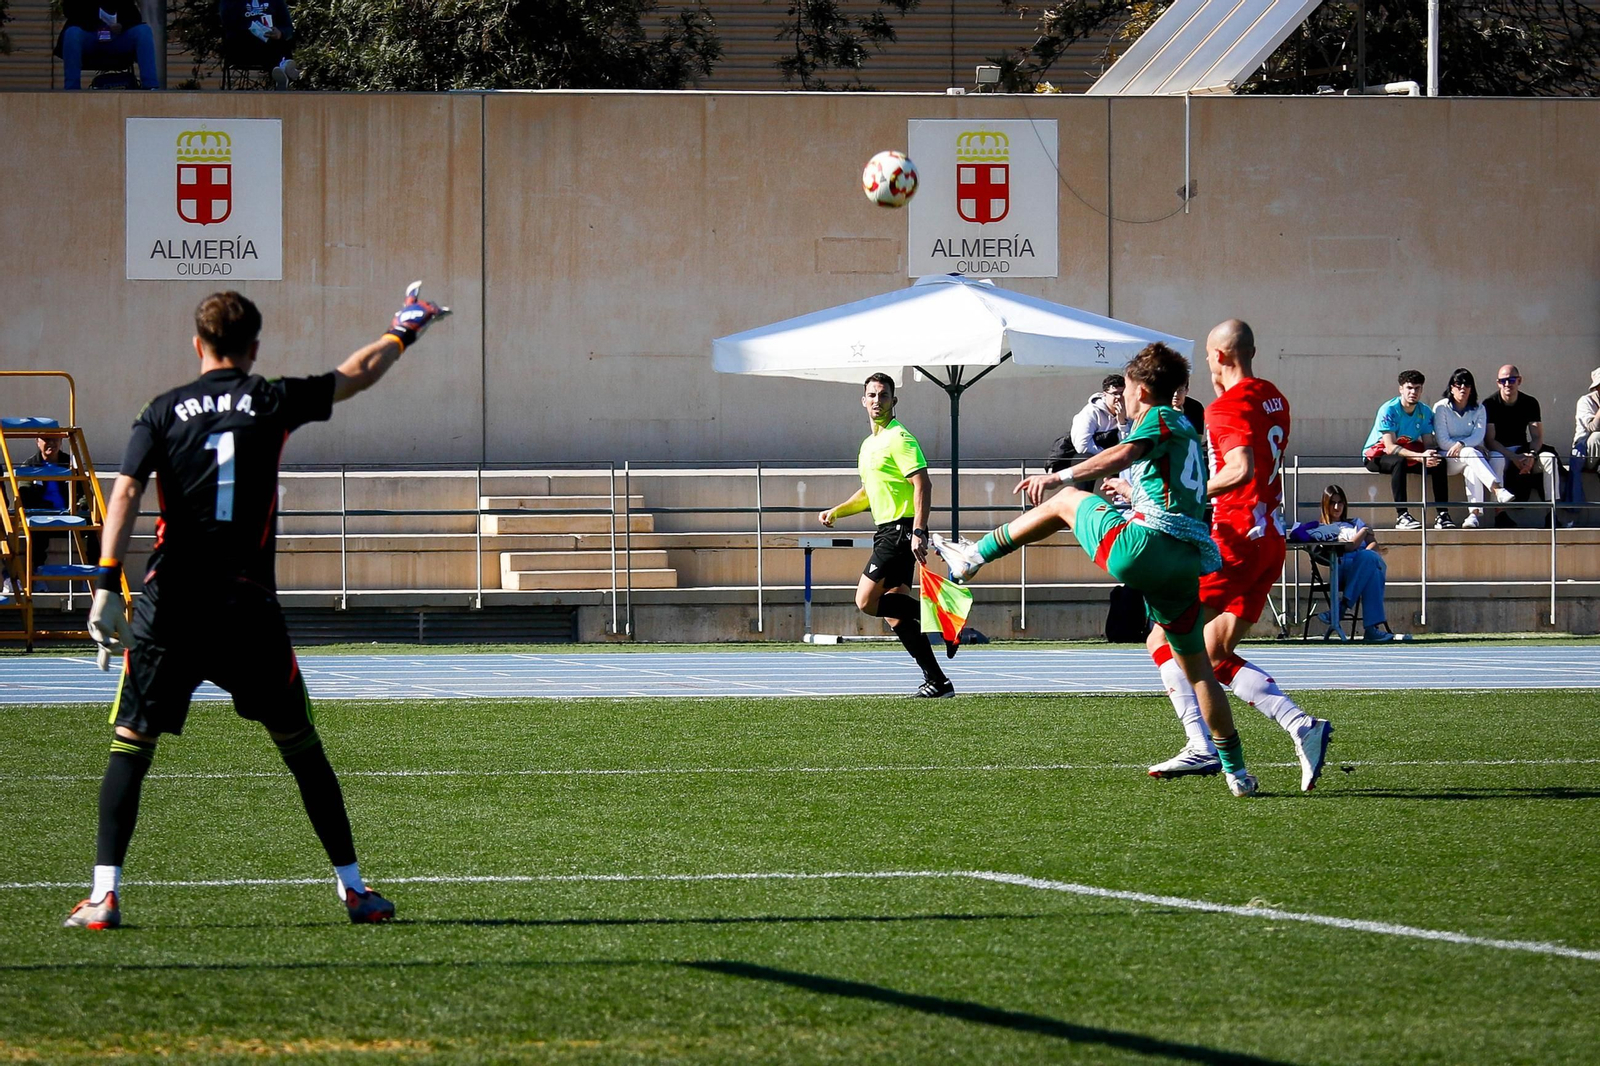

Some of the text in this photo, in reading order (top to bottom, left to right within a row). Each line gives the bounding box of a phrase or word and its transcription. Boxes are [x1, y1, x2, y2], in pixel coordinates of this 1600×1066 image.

[150, 234, 259, 260] ALMERÍA
[929, 233, 1036, 258] ALMERÍA
[176, 262, 232, 275] CIUDAD
[956, 260, 1010, 273] CIUDAD
[174, 393, 256, 422] FRAN A.
[1262, 397, 1283, 415] ALEX
[203, 431, 235, 521] 1
[1180, 438, 1204, 504] 4
